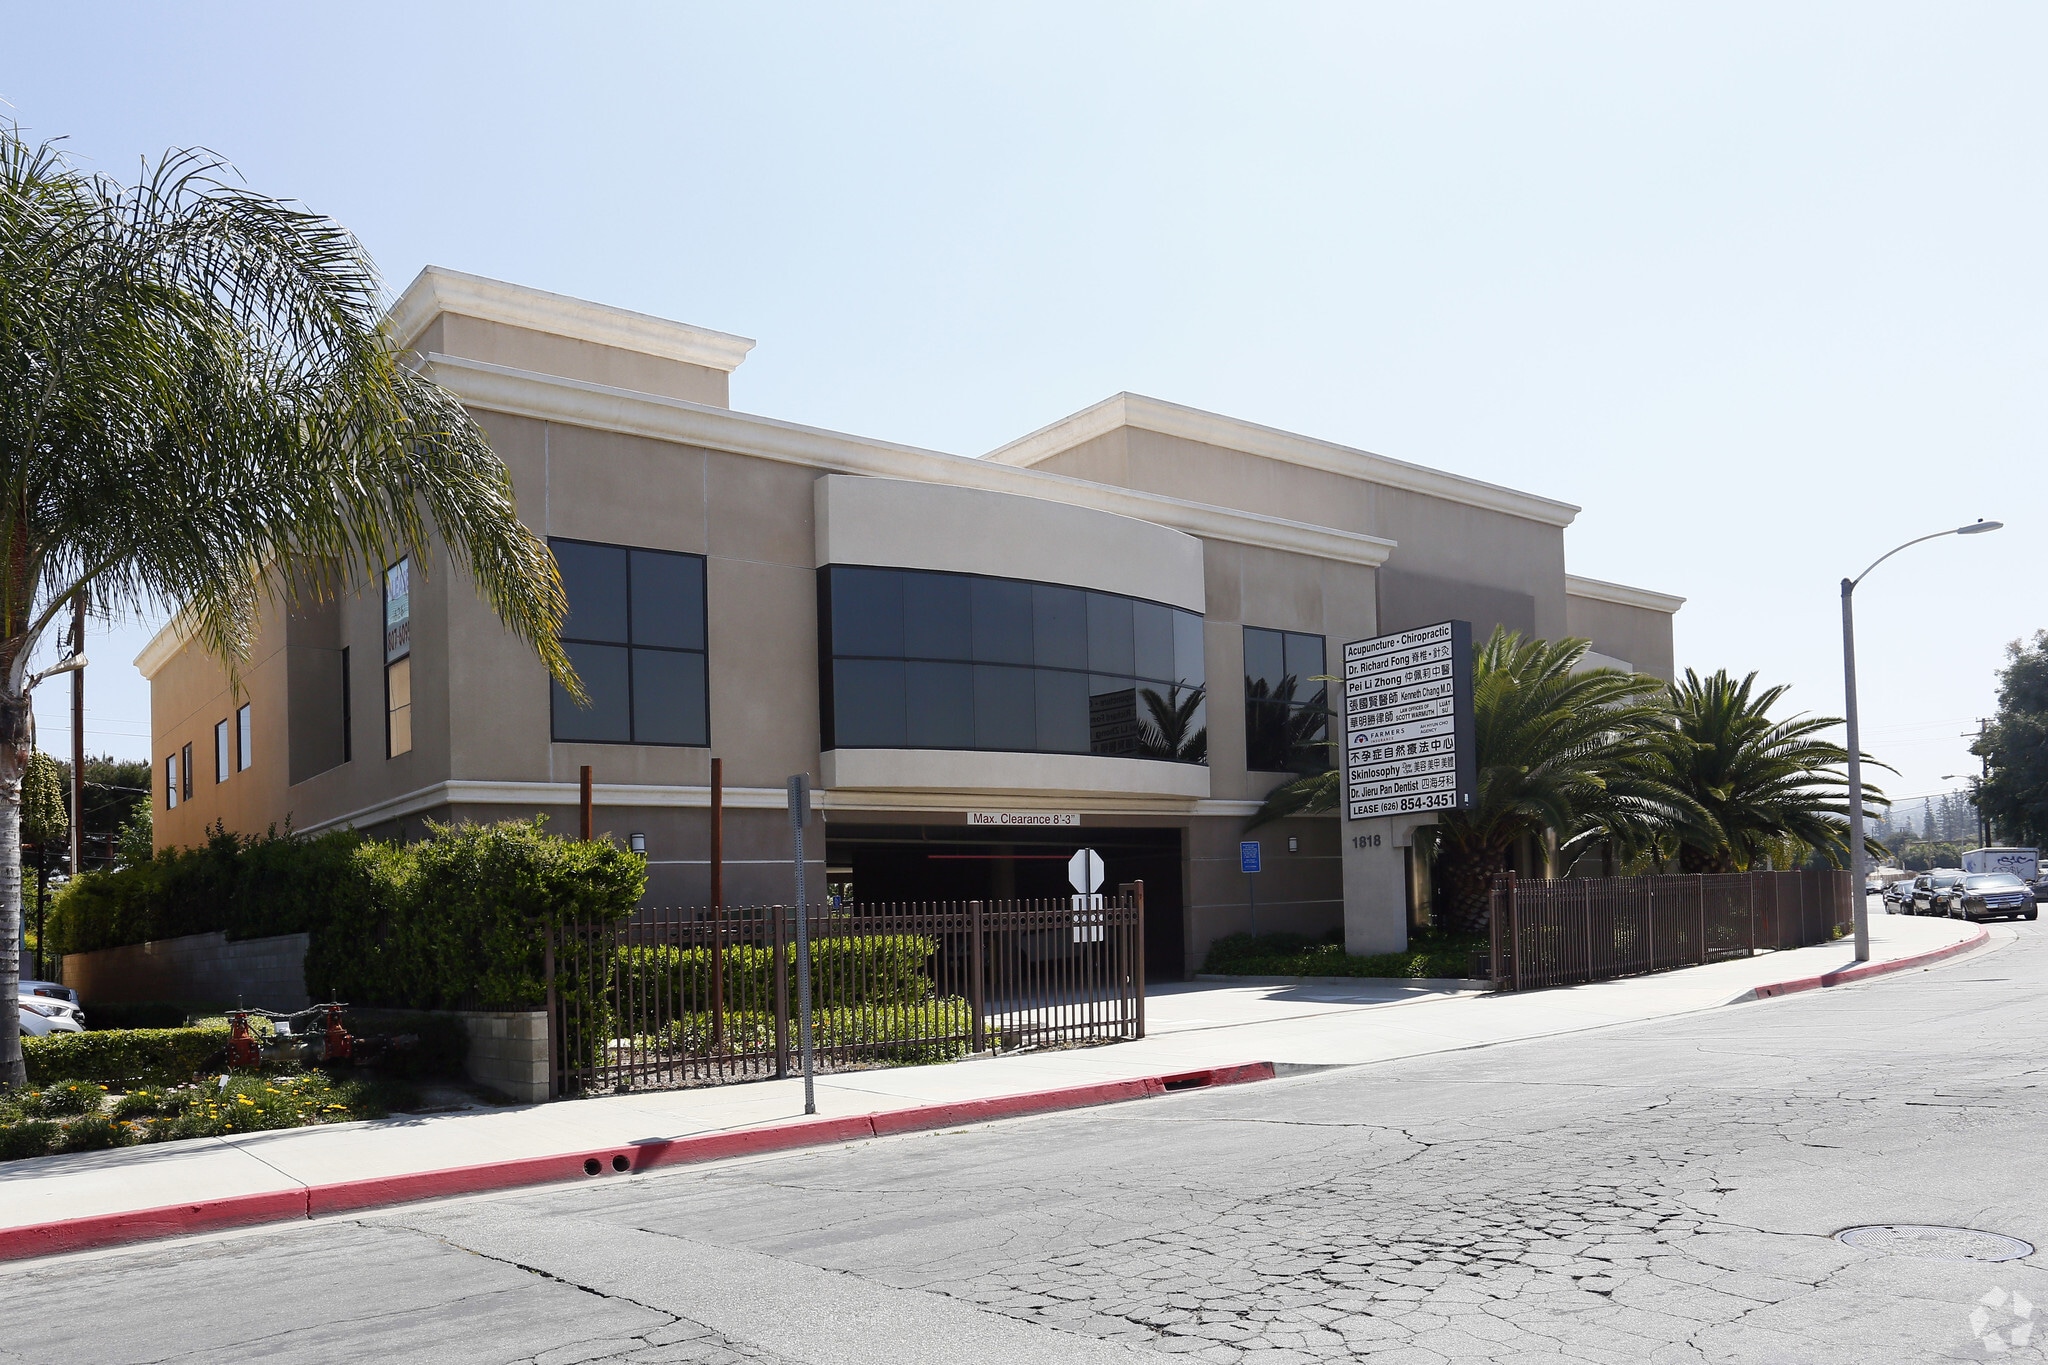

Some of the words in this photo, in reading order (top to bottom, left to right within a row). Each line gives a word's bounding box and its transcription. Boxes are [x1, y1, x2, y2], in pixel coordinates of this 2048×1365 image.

[1348, 639, 1395, 657] Acupuncture
[1401, 626, 1449, 645] Chiropractic
[1348, 665, 1359, 675] Dr.
[1360, 658, 1389, 673] Richard
[1391, 655, 1410, 668] Fong
[1349, 680, 1362, 692] Pei
[1364, 678, 1373, 690] Li
[1374, 675, 1402, 688] Zhong
[1400, 689, 1421, 701] Kenneth
[1422, 686, 1440, 697] Chang
[1440, 682, 1453, 693] M.D.
[1395, 714, 1411, 722] SCOTT
[1411, 709, 1435, 719] WARMUTH
[1408, 705, 1424, 713] OFFICES
[1370, 727, 1405, 739] FARMERS
[1350, 737, 1454, 764] 不孕症自然療法中心
[1351, 766, 1400, 781] Skinlosophy
[1351, 788, 1360, 798] Dr.
[1361, 786, 1379, 798] Jieru
[1380, 784, 1393, 795] Pan
[1394, 780, 1419, 793] Dentist
[1353, 804, 1379, 815] LEASE
[1381, 801, 1399, 812] (626)
[1400, 793, 1455, 811] 854-3451
[973, 813, 998, 824] Max.
[1000, 813, 1051, 824] Clearance
[1352, 834, 1381, 848] 1818
